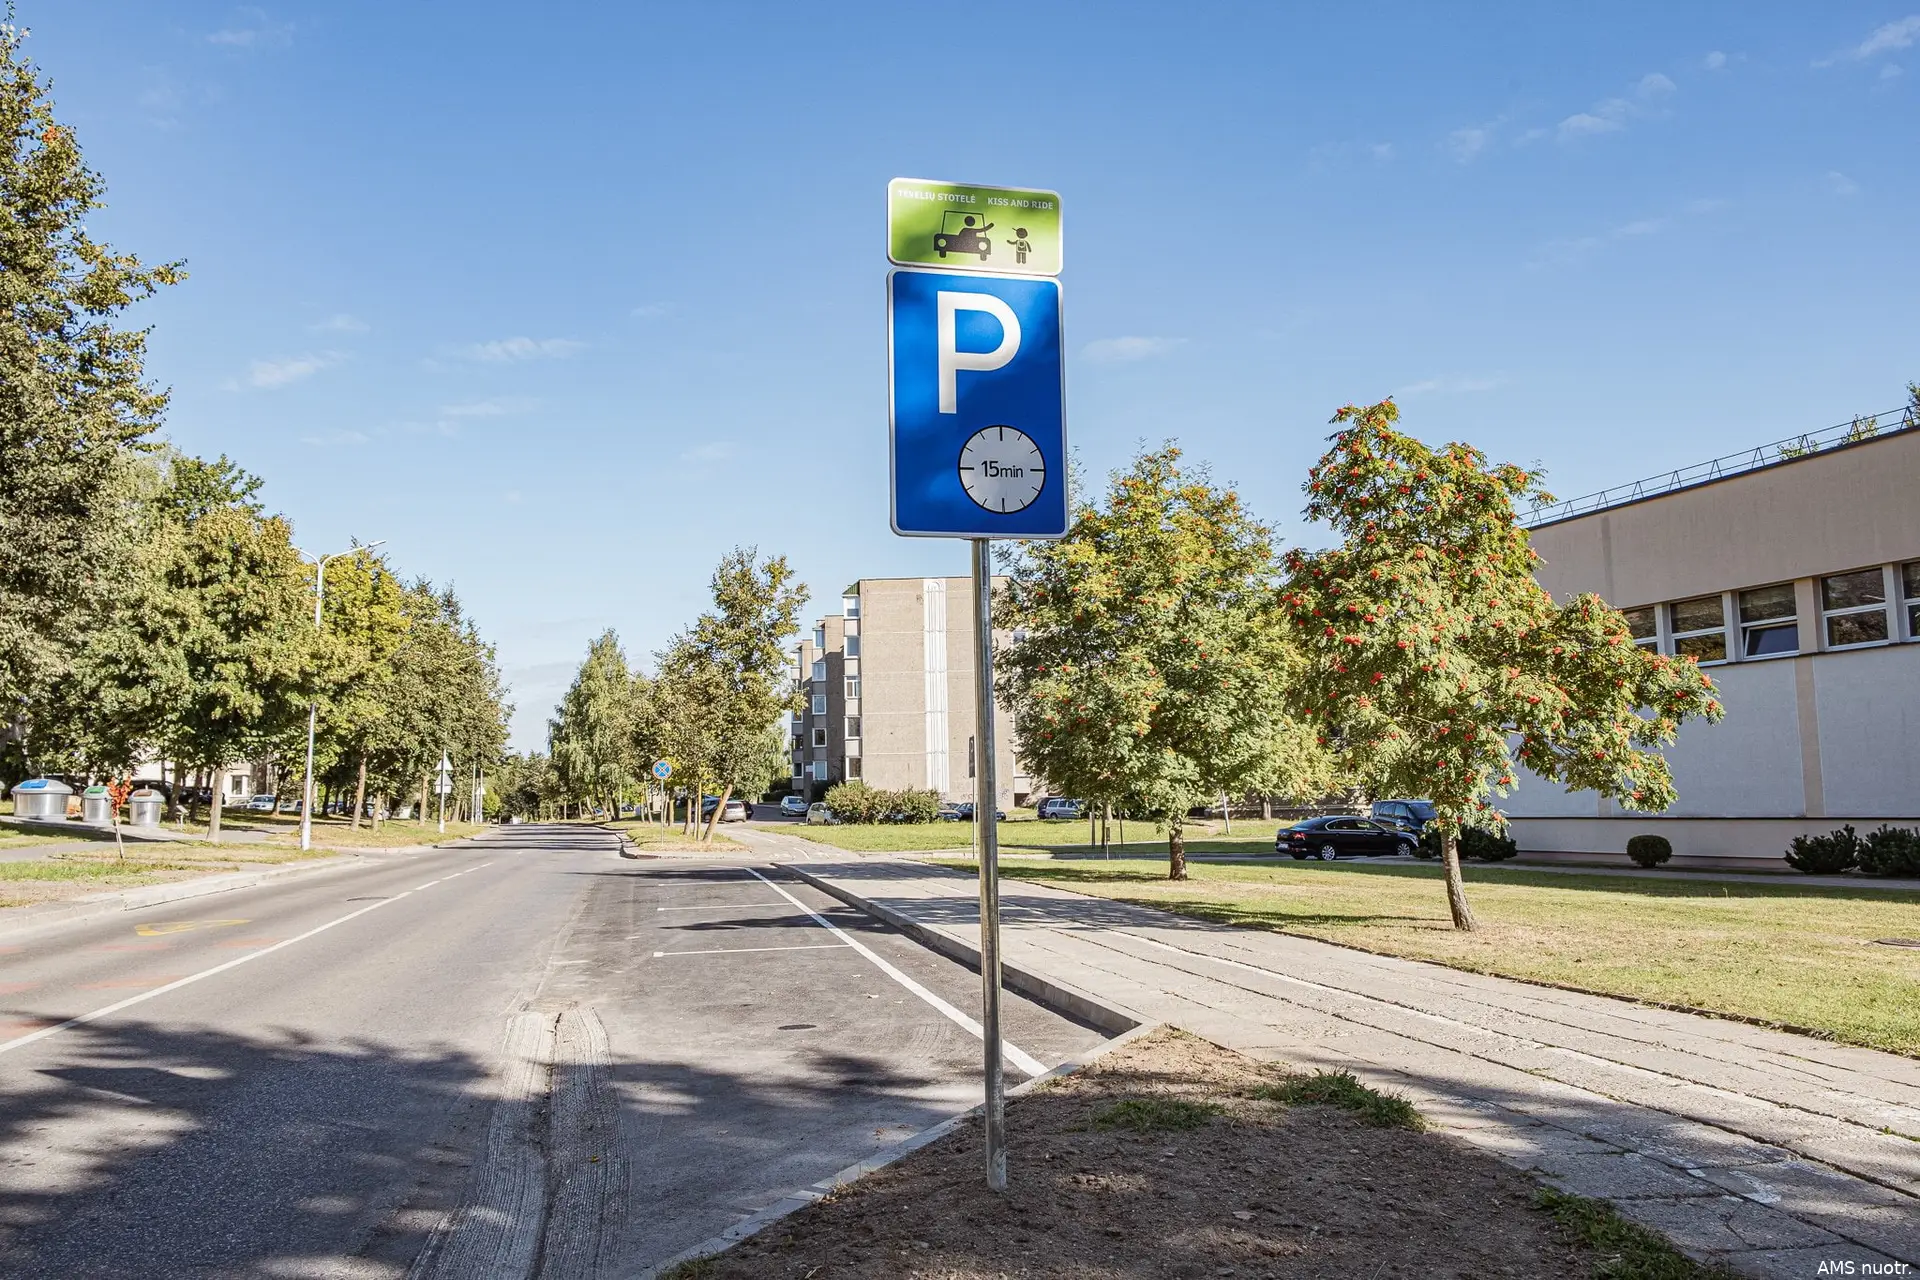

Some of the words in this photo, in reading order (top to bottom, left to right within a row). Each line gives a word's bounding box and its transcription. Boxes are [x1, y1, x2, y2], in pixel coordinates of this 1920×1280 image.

[987, 197, 1009, 207] KISS
[1011, 199, 1030, 208] AND
[1031, 200, 1053, 210] RIDE
[937, 290, 1022, 414] P
[981, 460, 1024, 478] 15min
